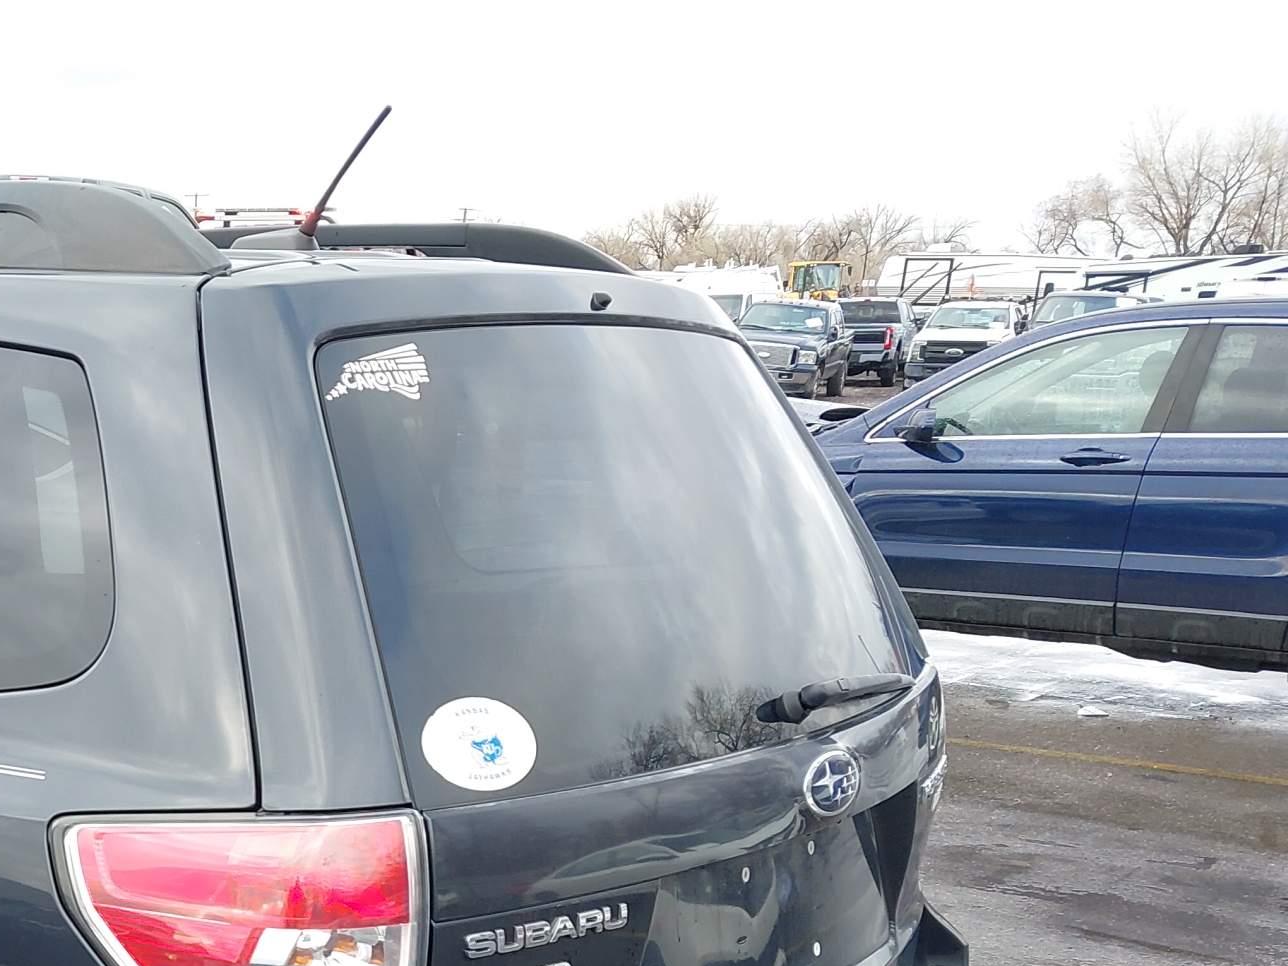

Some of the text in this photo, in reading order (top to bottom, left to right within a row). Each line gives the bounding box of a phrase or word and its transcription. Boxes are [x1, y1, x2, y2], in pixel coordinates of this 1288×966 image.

[349, 359, 398, 374] NORTH
[341, 370, 423, 392] CAROLINA
[464, 903, 628, 959] SUBARU
